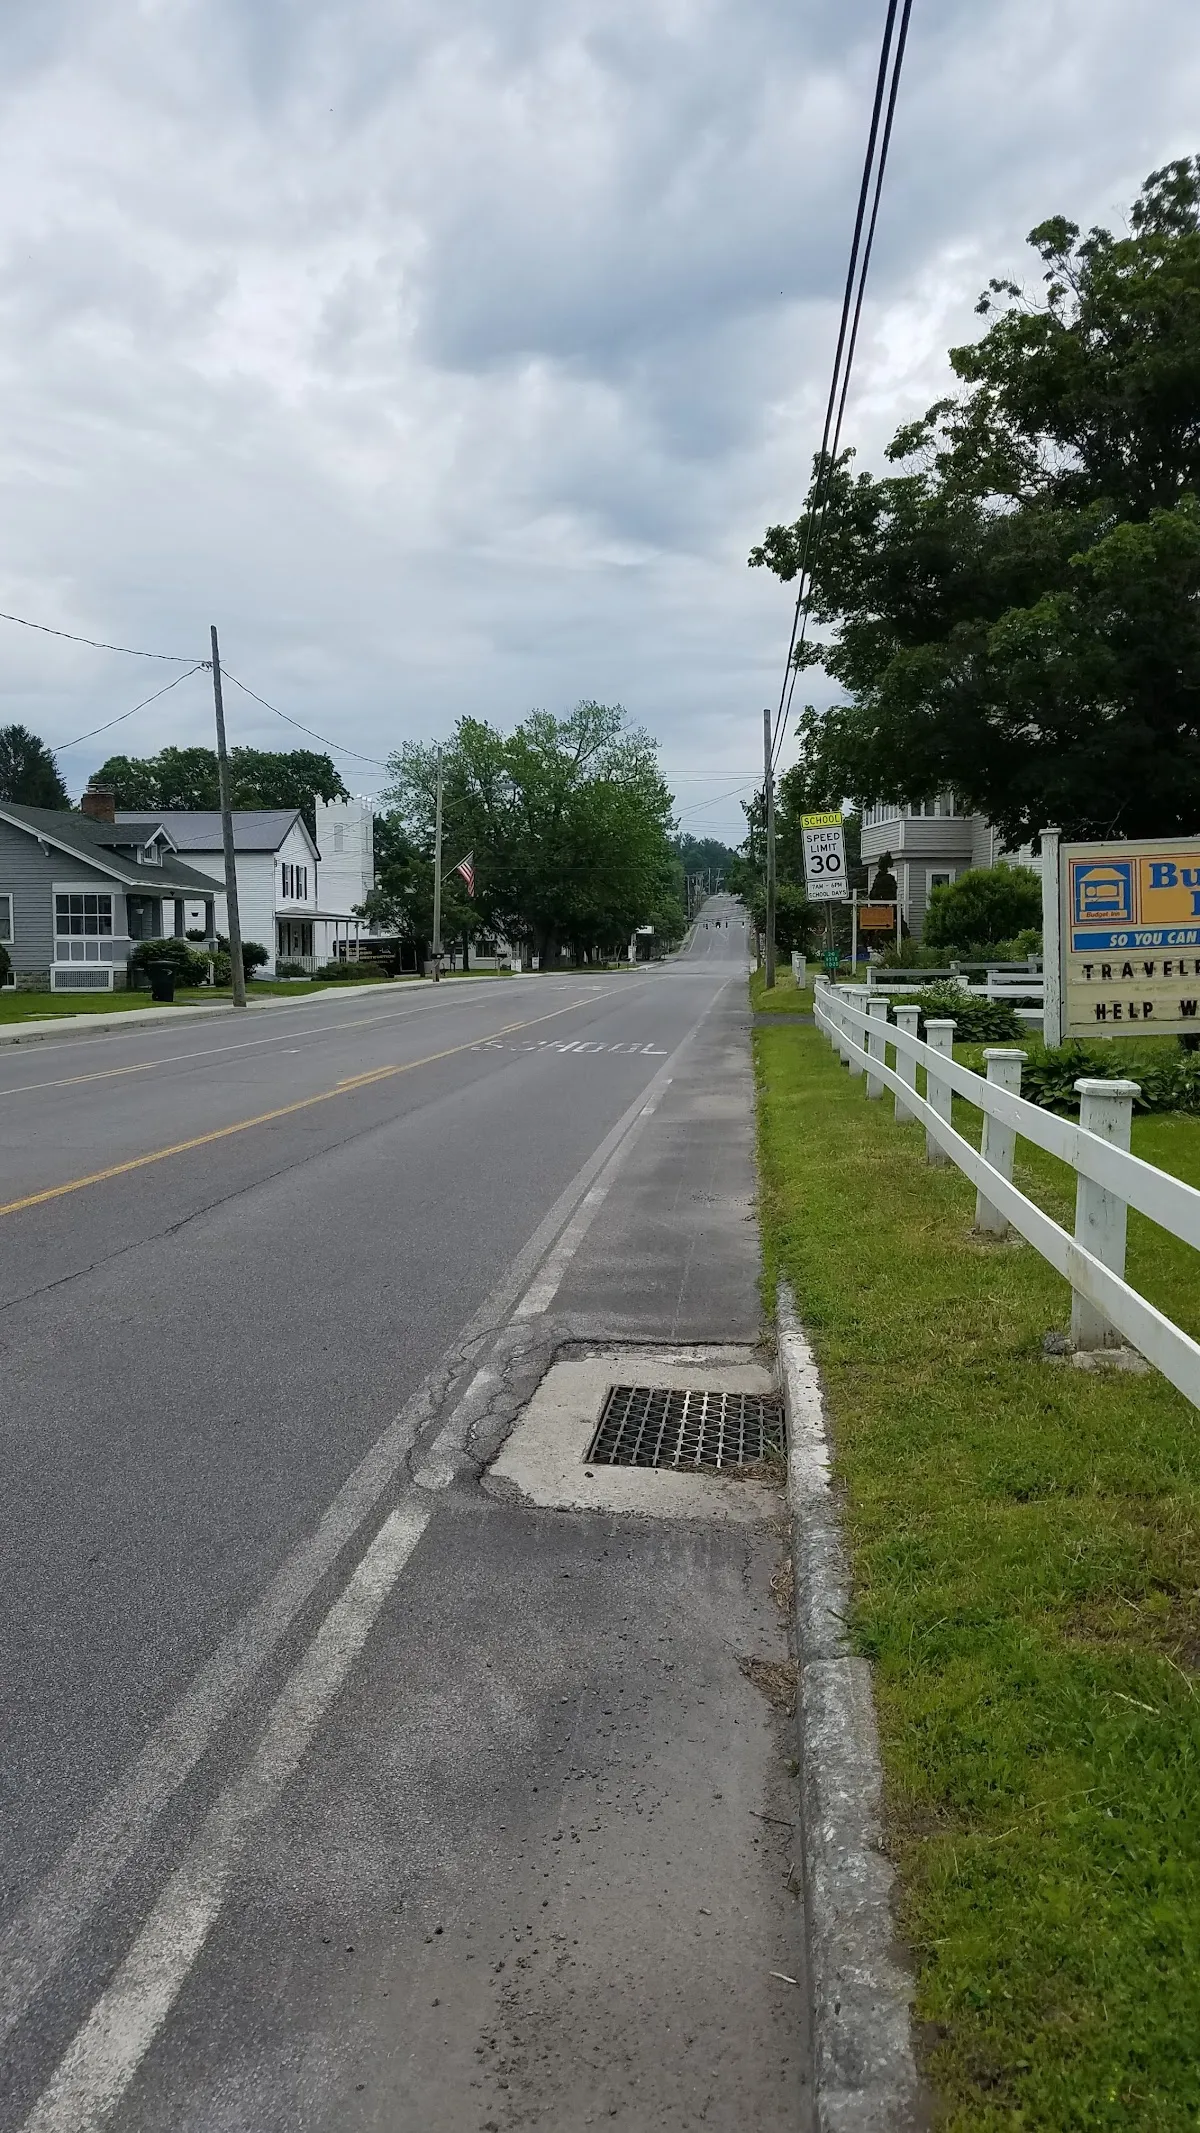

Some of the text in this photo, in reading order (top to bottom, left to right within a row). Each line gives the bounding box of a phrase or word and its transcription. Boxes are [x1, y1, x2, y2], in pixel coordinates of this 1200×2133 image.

[804, 814, 840, 825] SCHOOL
[806, 832, 840, 843] SPEED
[810, 843, 837, 853] LIMIT
[810, 853, 841, 874] 30
[808, 889, 847, 899] SCHOOL DAYS
[1086, 911, 1109, 919] Budget
[1109, 930, 1198, 948] SO YOU CAN
[1096, 1001, 1154, 1019] HELP
